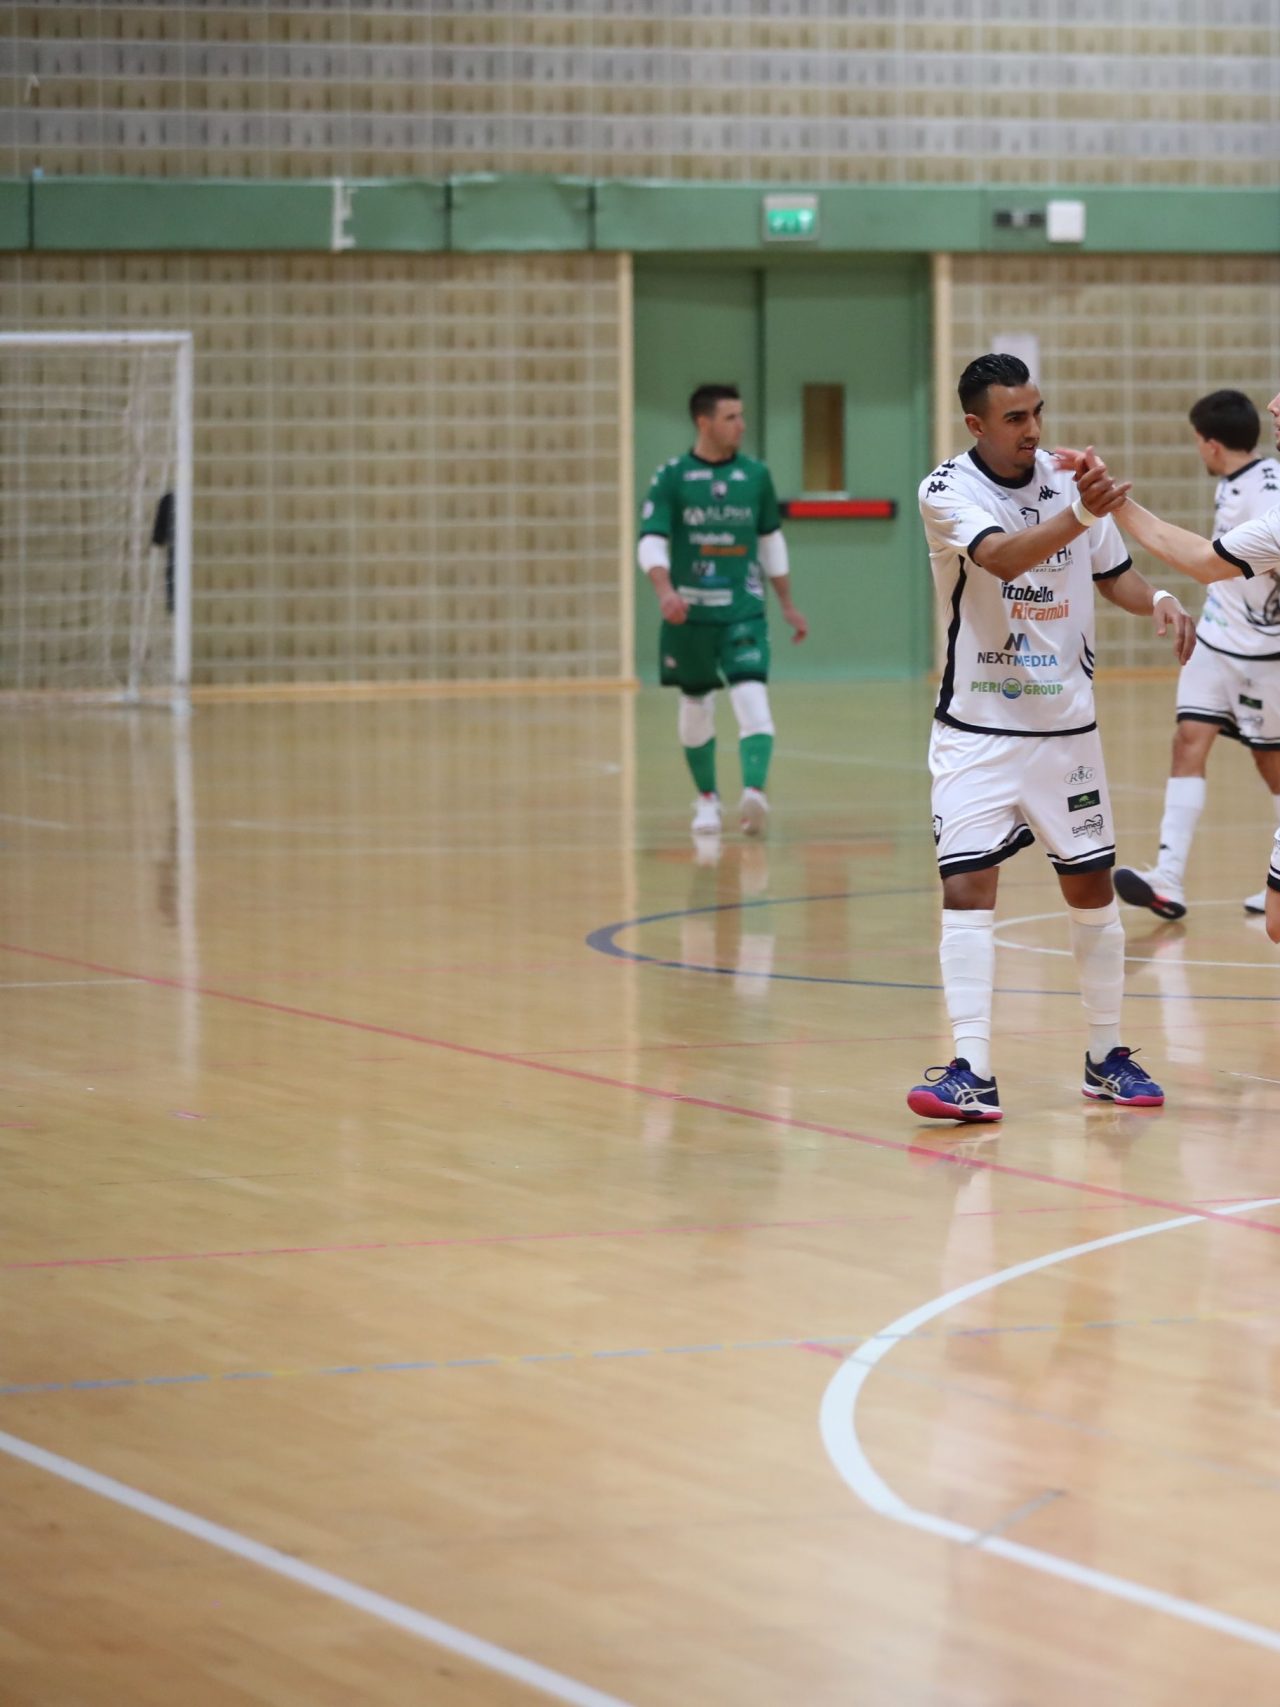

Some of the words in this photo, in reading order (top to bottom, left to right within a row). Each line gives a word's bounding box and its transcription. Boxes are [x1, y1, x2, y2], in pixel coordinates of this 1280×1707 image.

[1011, 599, 1070, 621] Ricambi
[977, 651, 1058, 668] NEXTMEDIA
[970, 681, 1001, 693] PIERI
[1023, 683, 1064, 695] GROUP
